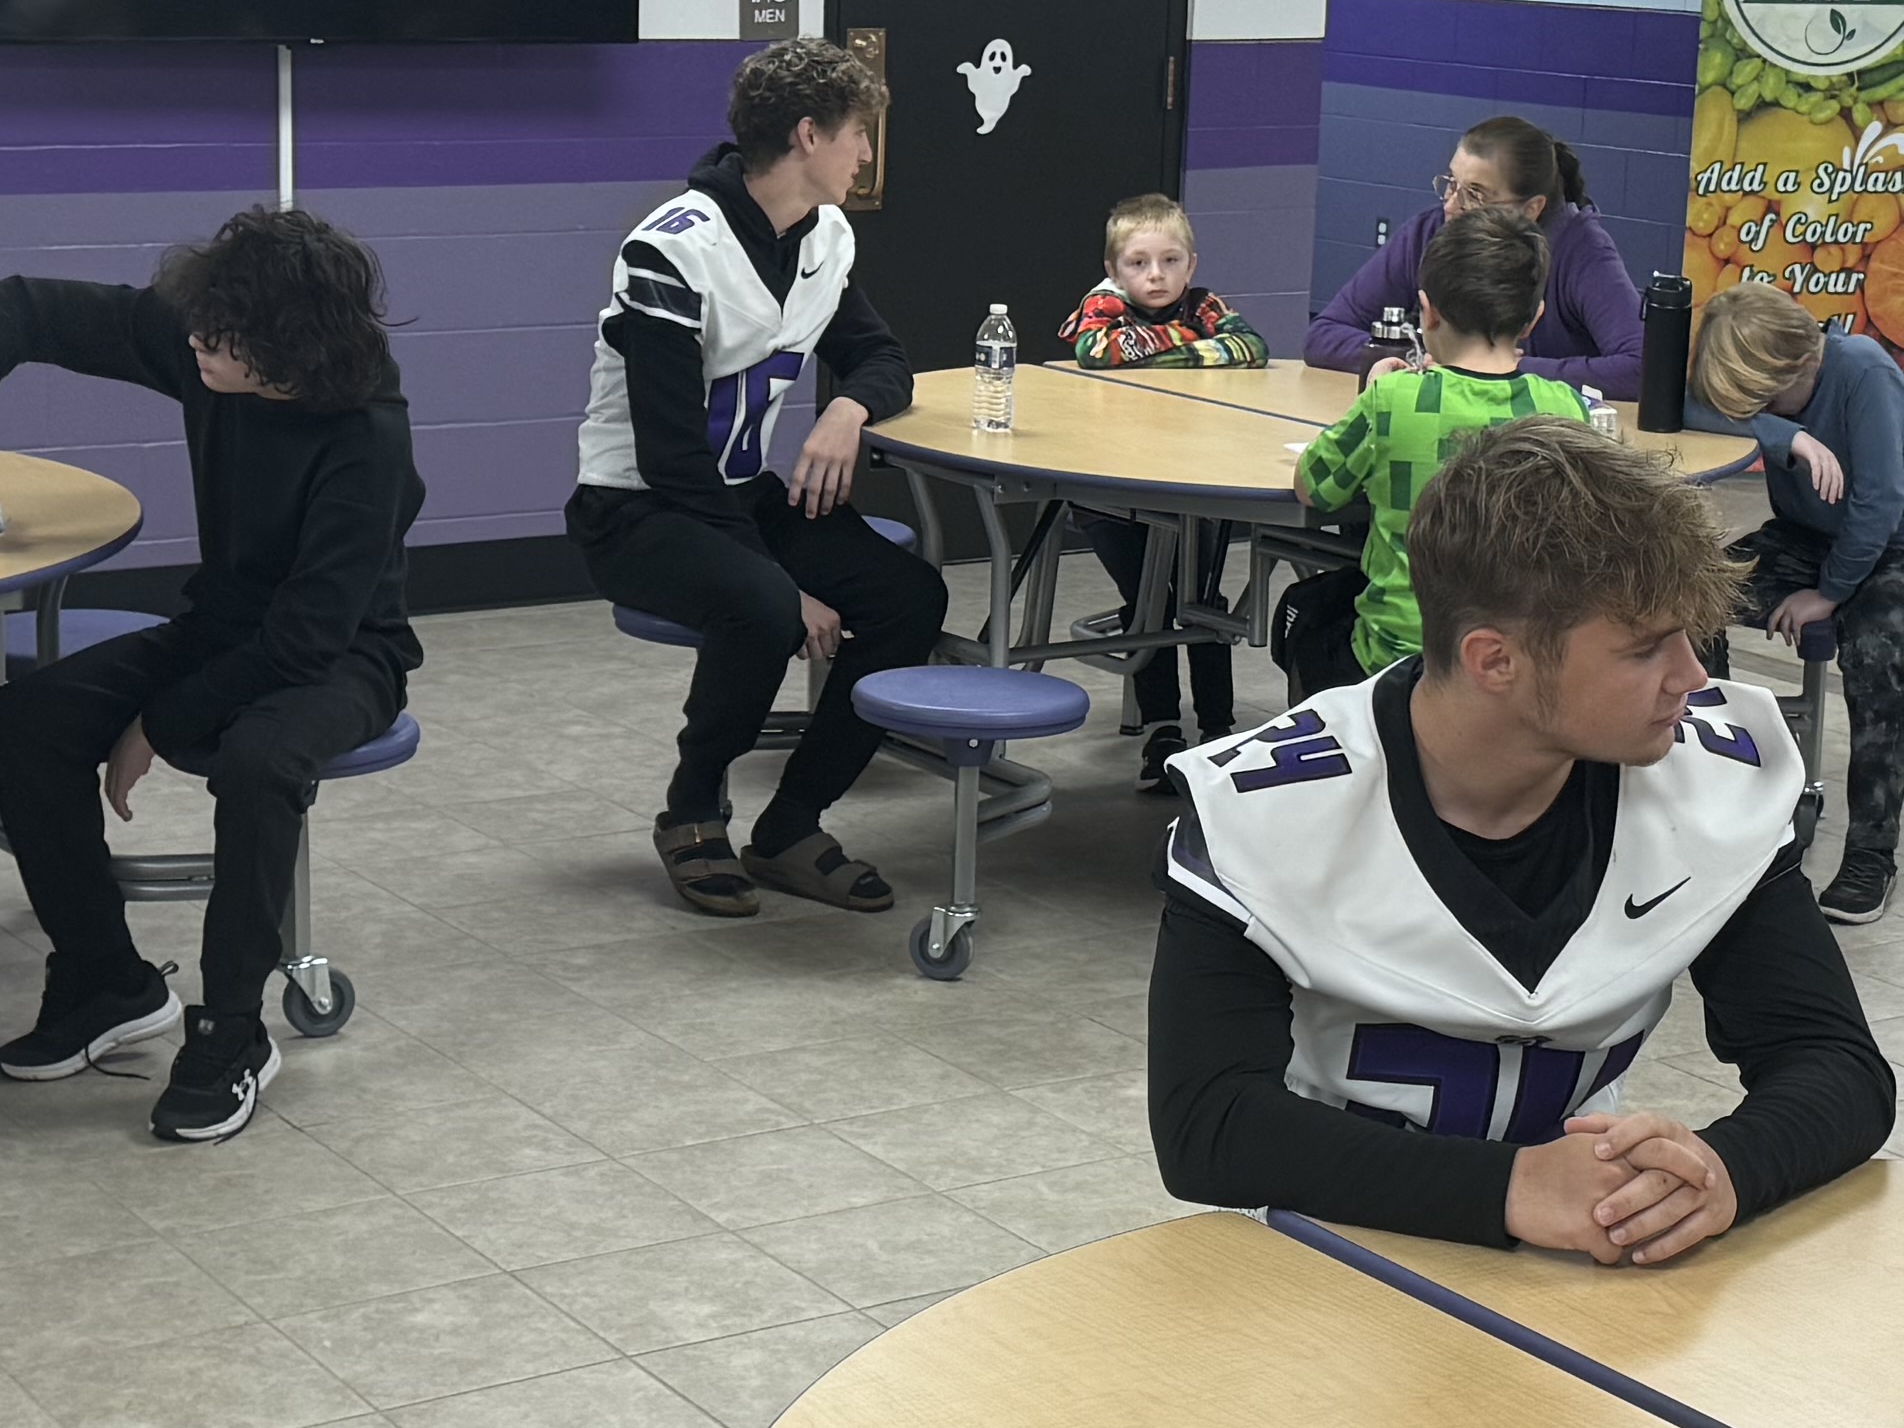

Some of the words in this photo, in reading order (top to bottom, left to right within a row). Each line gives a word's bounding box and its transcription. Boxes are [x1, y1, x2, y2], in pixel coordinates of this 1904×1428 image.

[753, 8, 786, 24] MEN
[1696, 160, 1767, 197] Add
[1775, 170, 1800, 194] a
[641, 206, 712, 236] 16
[1738, 212, 1777, 253] of
[1783, 212, 1875, 245] Color
[1784, 263, 1866, 295] Your
